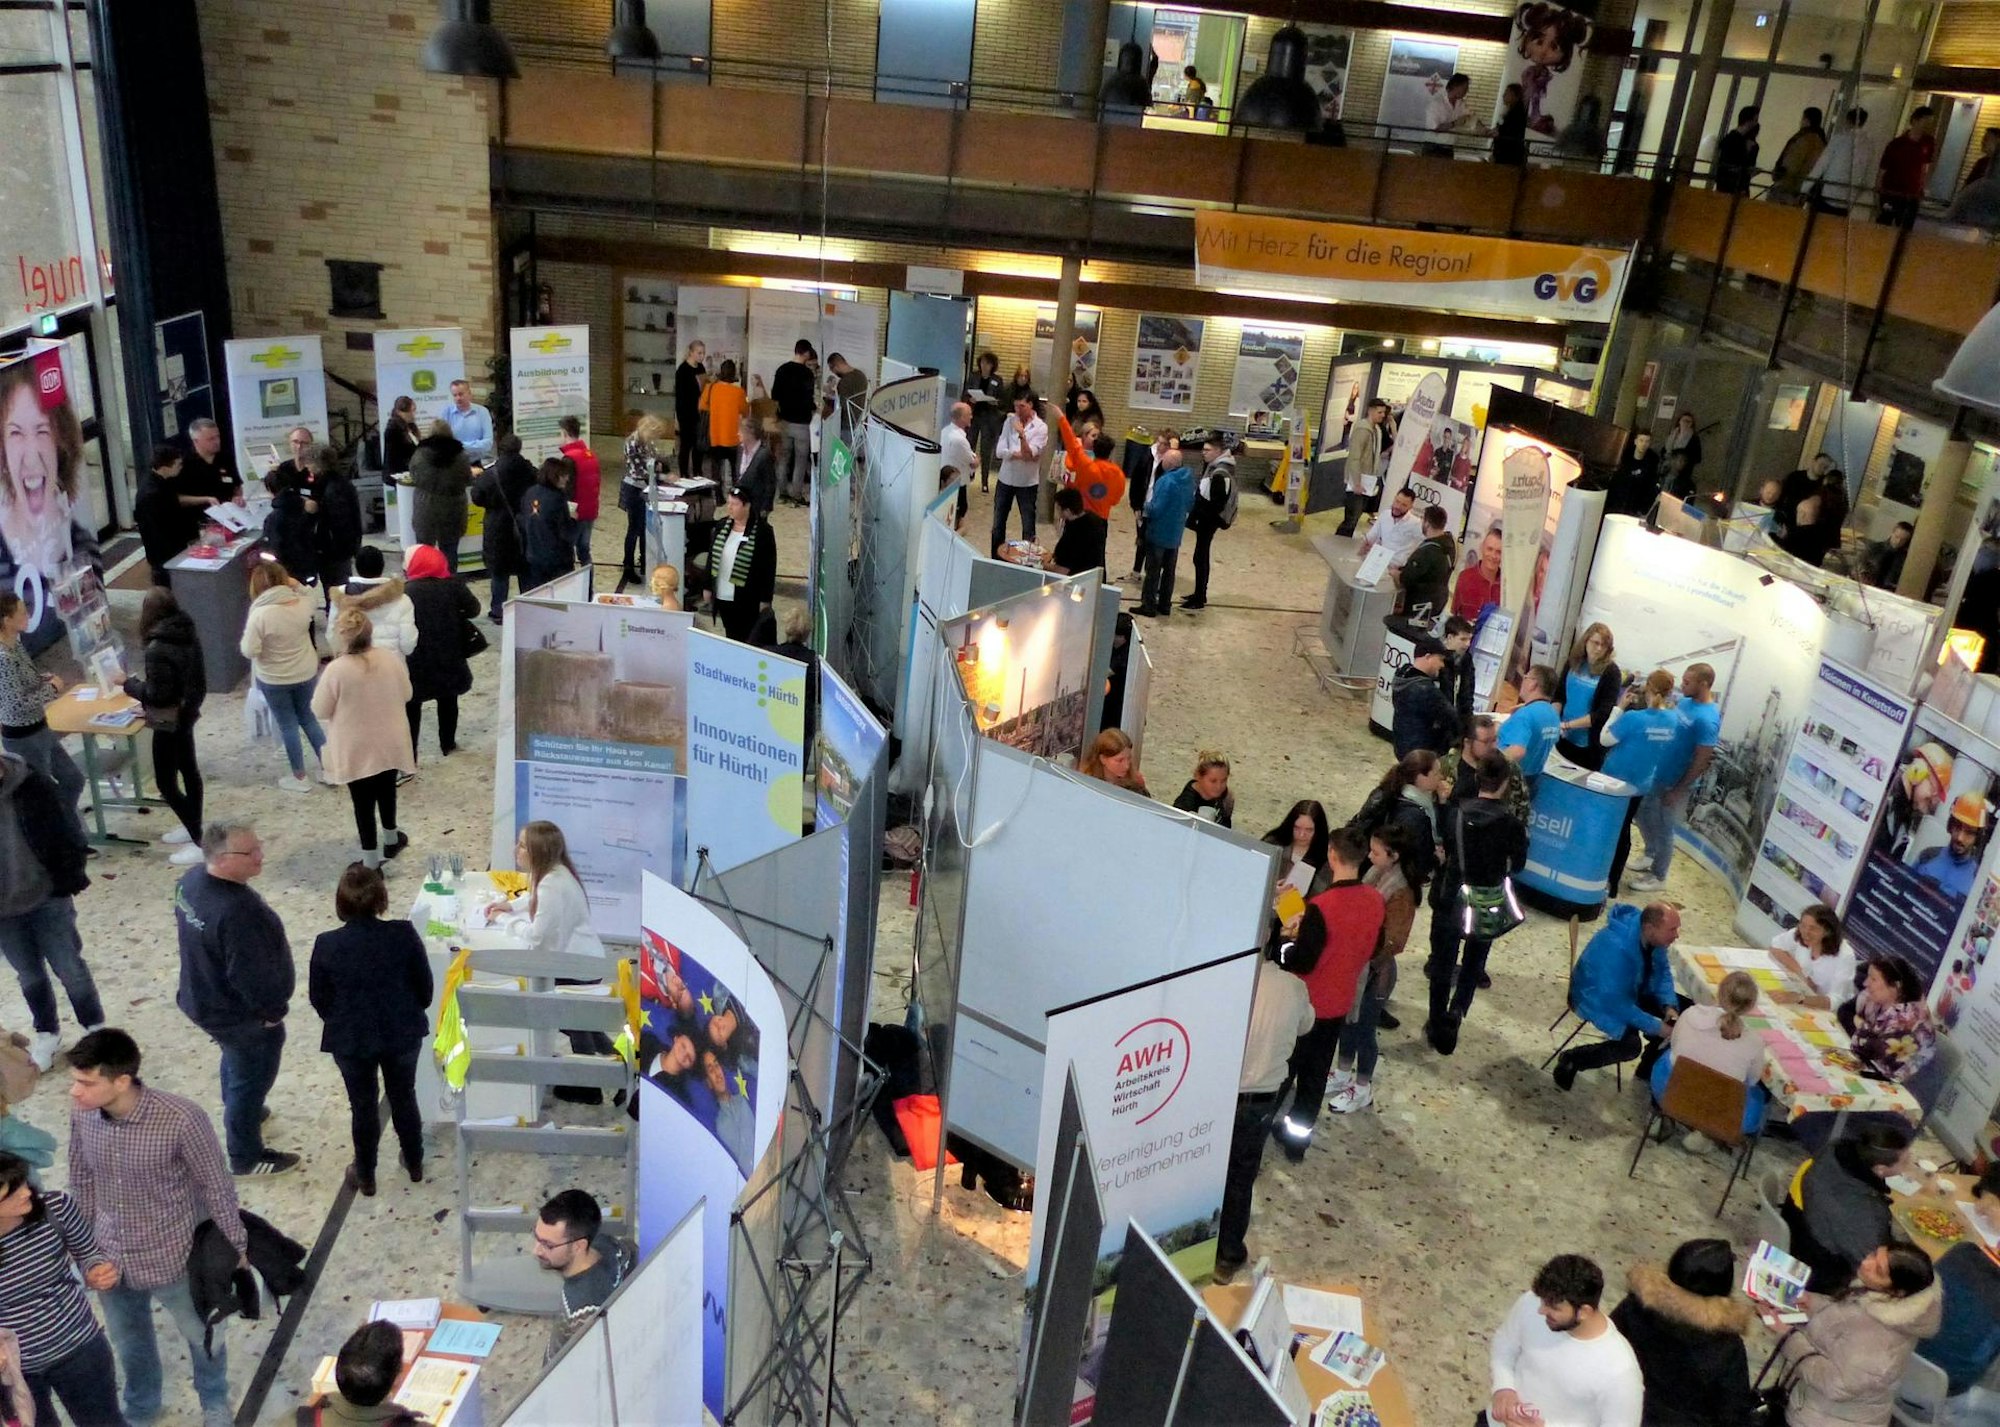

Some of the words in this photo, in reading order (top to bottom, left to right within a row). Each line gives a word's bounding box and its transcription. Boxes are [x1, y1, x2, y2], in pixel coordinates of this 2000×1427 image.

[1202, 226, 1238, 250] Mit
[1248, 231, 1300, 257] Herz
[1307, 233, 1338, 260] für
[1346, 238, 1381, 266] die
[1389, 245, 1472, 276] Region!
[1534, 274, 1598, 303] GVG
[517, 367, 569, 378] Ausbildung
[571, 366, 584, 374] 4.0
[694, 661, 757, 692] Stadtwerke
[768, 684, 799, 706] Hürth
[1820, 664, 1852, 692] Visionen
[1852, 684, 1862, 698] in
[1861, 690, 1906, 723] Kunststoff
[534, 739, 574, 750] Schützen
[576, 743, 590, 751] Sie
[592, 744, 603, 753] Ihr
[605, 746, 627, 755] Haus
[629, 749, 644, 757] vor
[693, 715, 798, 767] Innovationen
[605, 757, 622, 765] aus
[623, 759, 642, 767] dem
[693, 743, 715, 766] für
[719, 751, 768, 784] Hürth!
[1527, 808, 1573, 839] asell
[1116, 1038, 1174, 1077] AWH
[1113, 1080, 1161, 1103] Wirtschaft
[1114, 1065, 1171, 1091] Arbeitskreis
[1112, 1100, 1138, 1116] Hürth
[1188, 1119, 1215, 1140] der
[1099, 1179, 1114, 1194] er
[1115, 1142, 1212, 1190] Unternehmen
